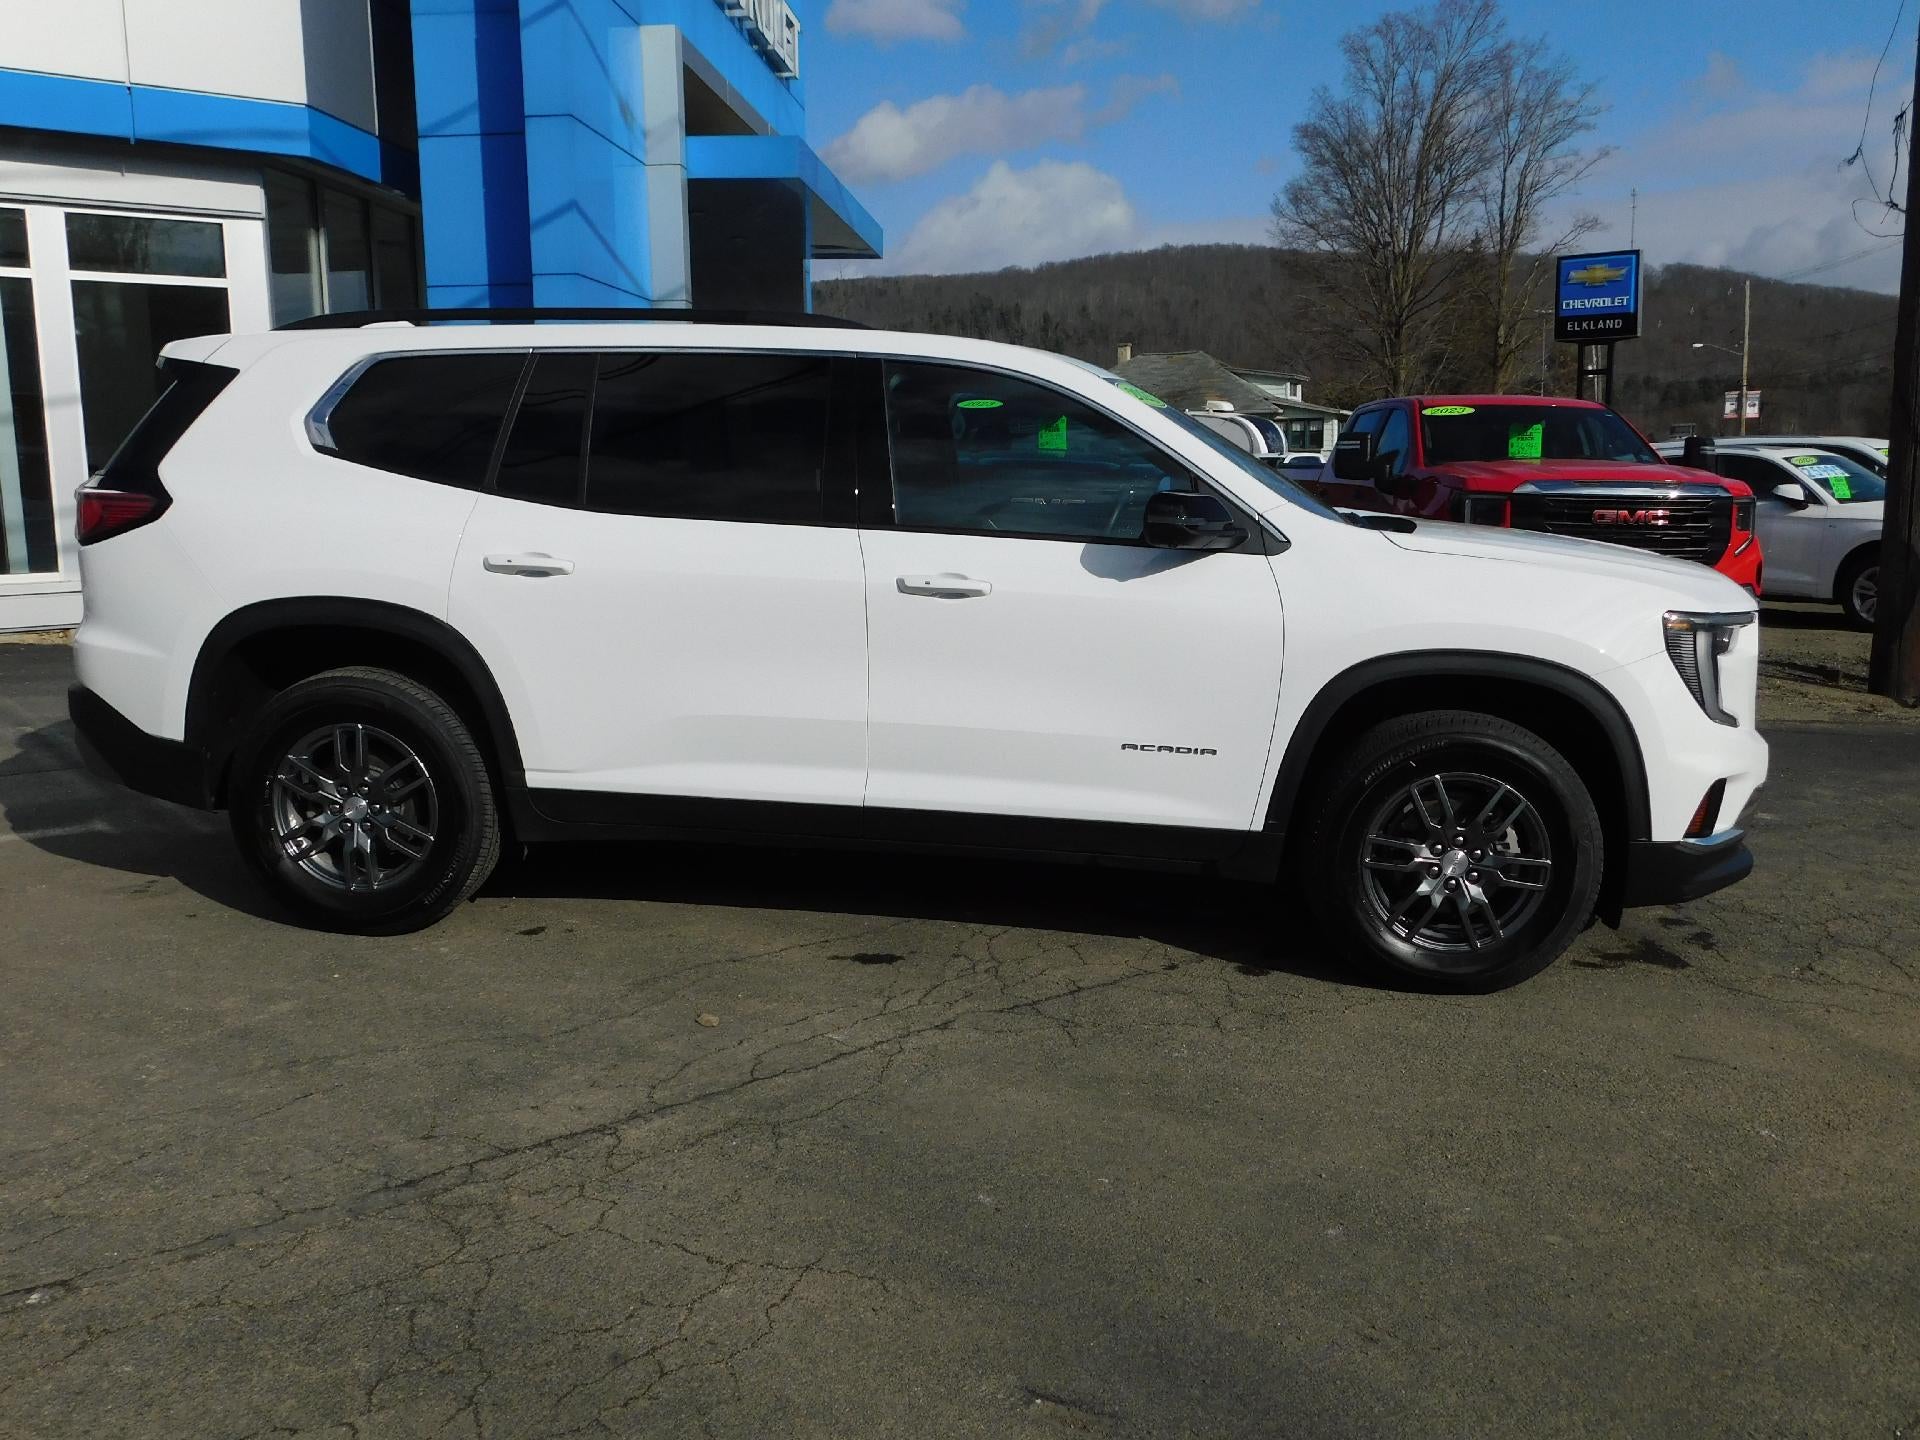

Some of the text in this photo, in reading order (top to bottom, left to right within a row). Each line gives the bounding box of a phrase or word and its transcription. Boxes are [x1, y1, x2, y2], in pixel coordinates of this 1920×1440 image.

[1562, 295, 1630, 310] CHEVROLET
[1567, 319, 1623, 331] ELKLAND
[1592, 509, 1670, 526] GMC
[1120, 743, 1218, 756] ACADIA
